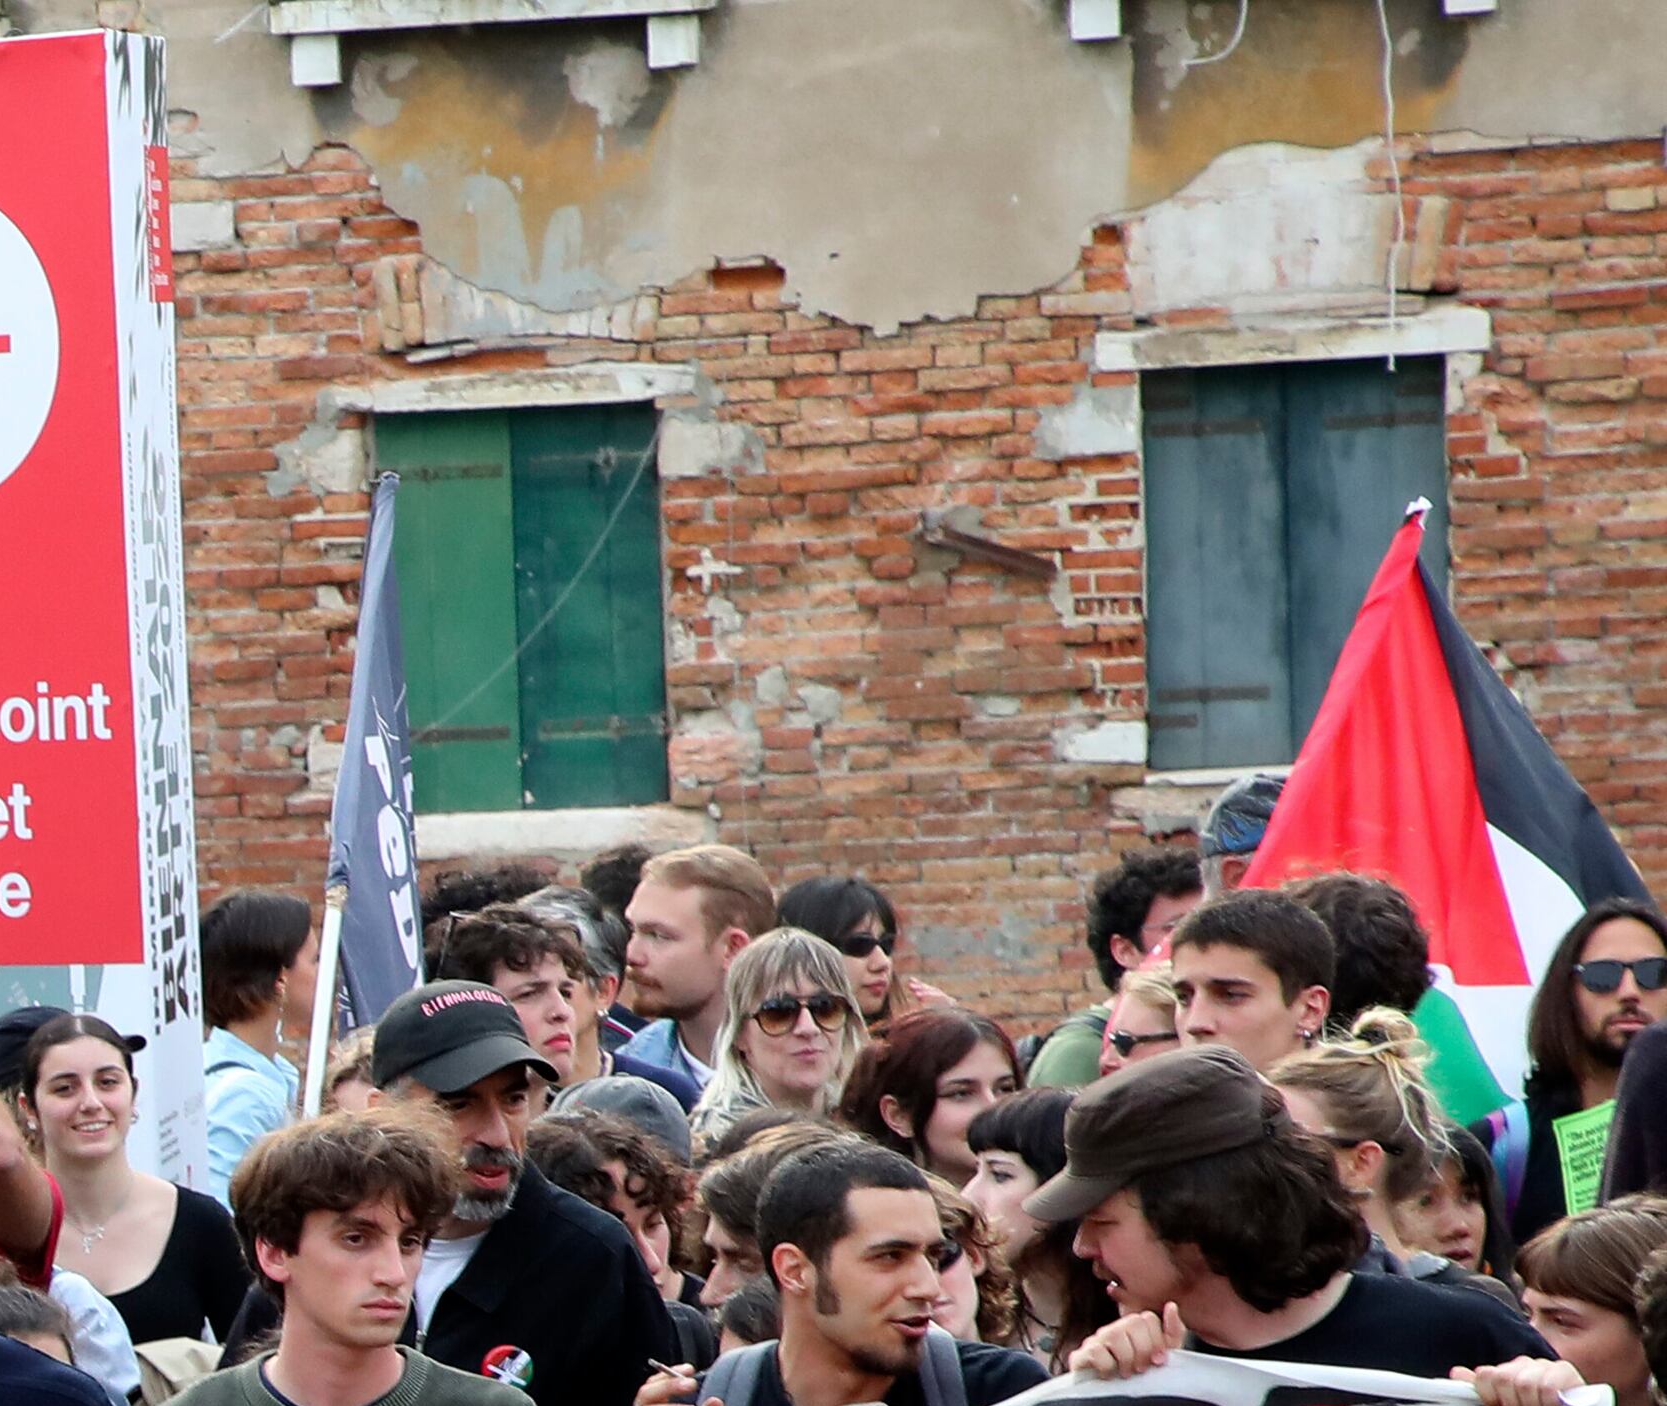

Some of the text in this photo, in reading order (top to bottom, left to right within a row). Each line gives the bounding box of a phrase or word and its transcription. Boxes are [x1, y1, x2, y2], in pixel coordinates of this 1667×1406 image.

[141, 488, 177, 1024] BIENNALE
[145, 810, 158, 971] MINOR
[152, 446, 190, 1018] ARTE 2026
[152, 985, 161, 1036] IN
